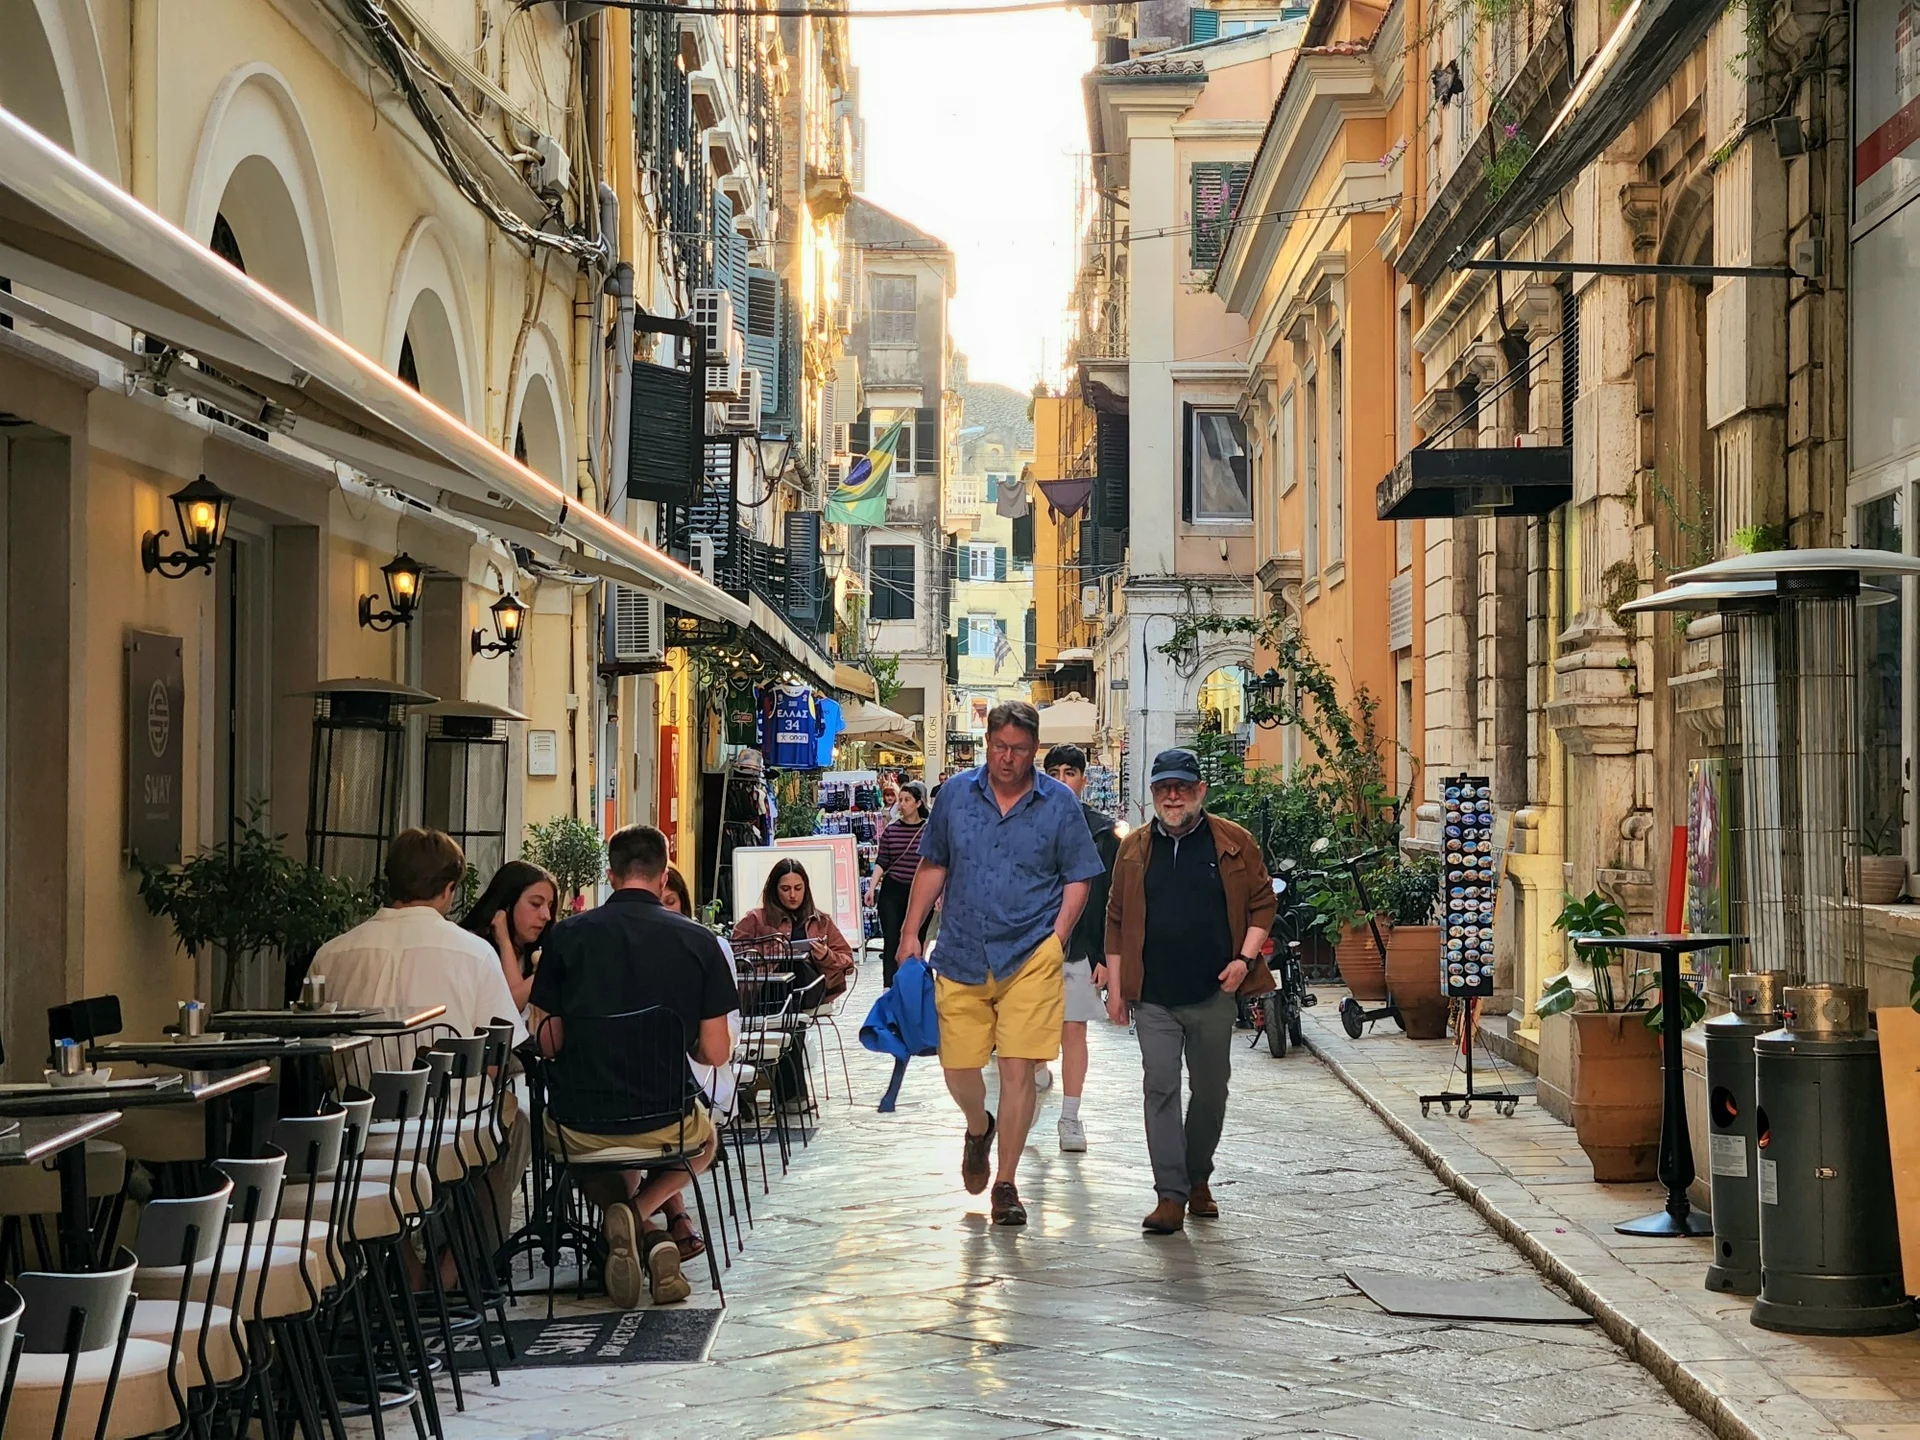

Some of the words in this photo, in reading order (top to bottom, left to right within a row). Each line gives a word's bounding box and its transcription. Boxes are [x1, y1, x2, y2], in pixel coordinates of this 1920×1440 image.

[785, 719, 800, 730] 34
[928, 716, 938, 739] Cost
[928, 740, 937, 757] Bill
[144, 774, 172, 804] SWAY
[524, 1322, 604, 1356] SWAY
